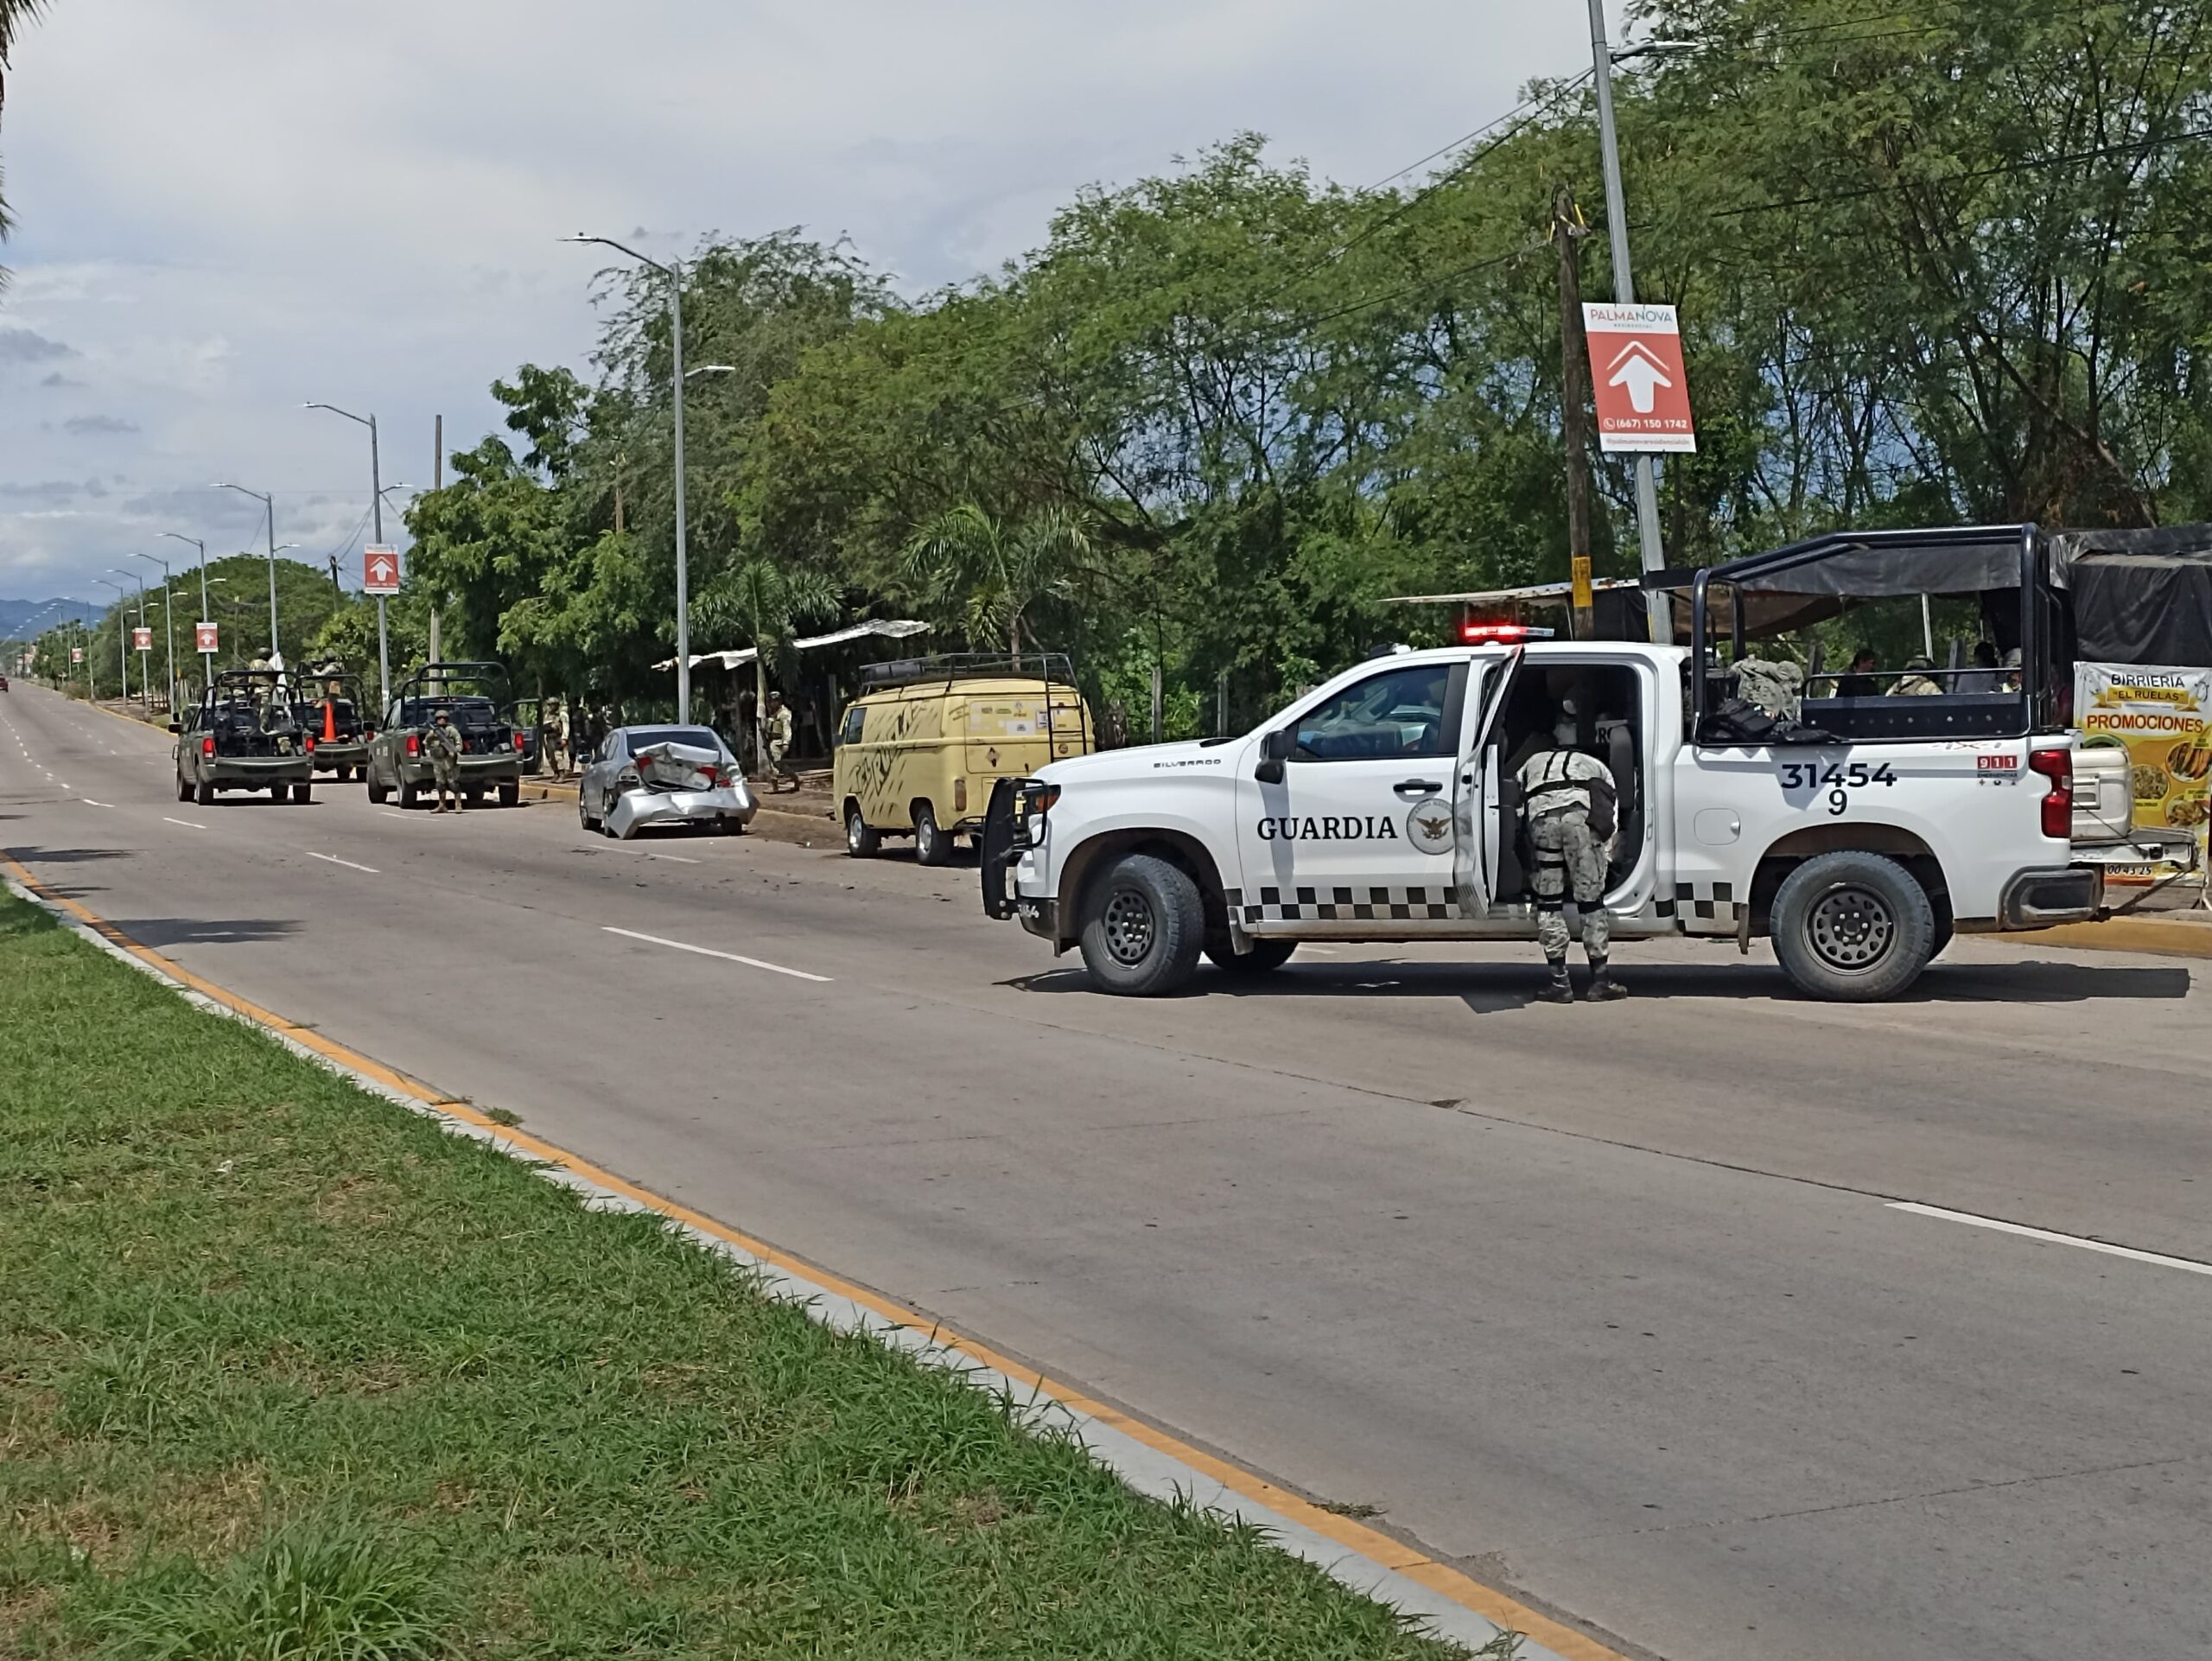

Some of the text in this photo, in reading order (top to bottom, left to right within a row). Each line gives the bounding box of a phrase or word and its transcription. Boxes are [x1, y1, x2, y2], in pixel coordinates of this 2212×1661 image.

[1590, 309, 1673, 322] PALMANOVA
[1616, 419, 1641, 429] (667)
[1643, 419, 1662, 429] 150
[2111, 674, 2185, 688] BIRRIERIA
[2087, 714, 2204, 733] PROMOCIONES
[1979, 757, 2015, 768] 911
[1780, 762, 1897, 788] 31454
[1827, 788, 1847, 816] 9
[1256, 816, 1399, 841] GUARDIA
